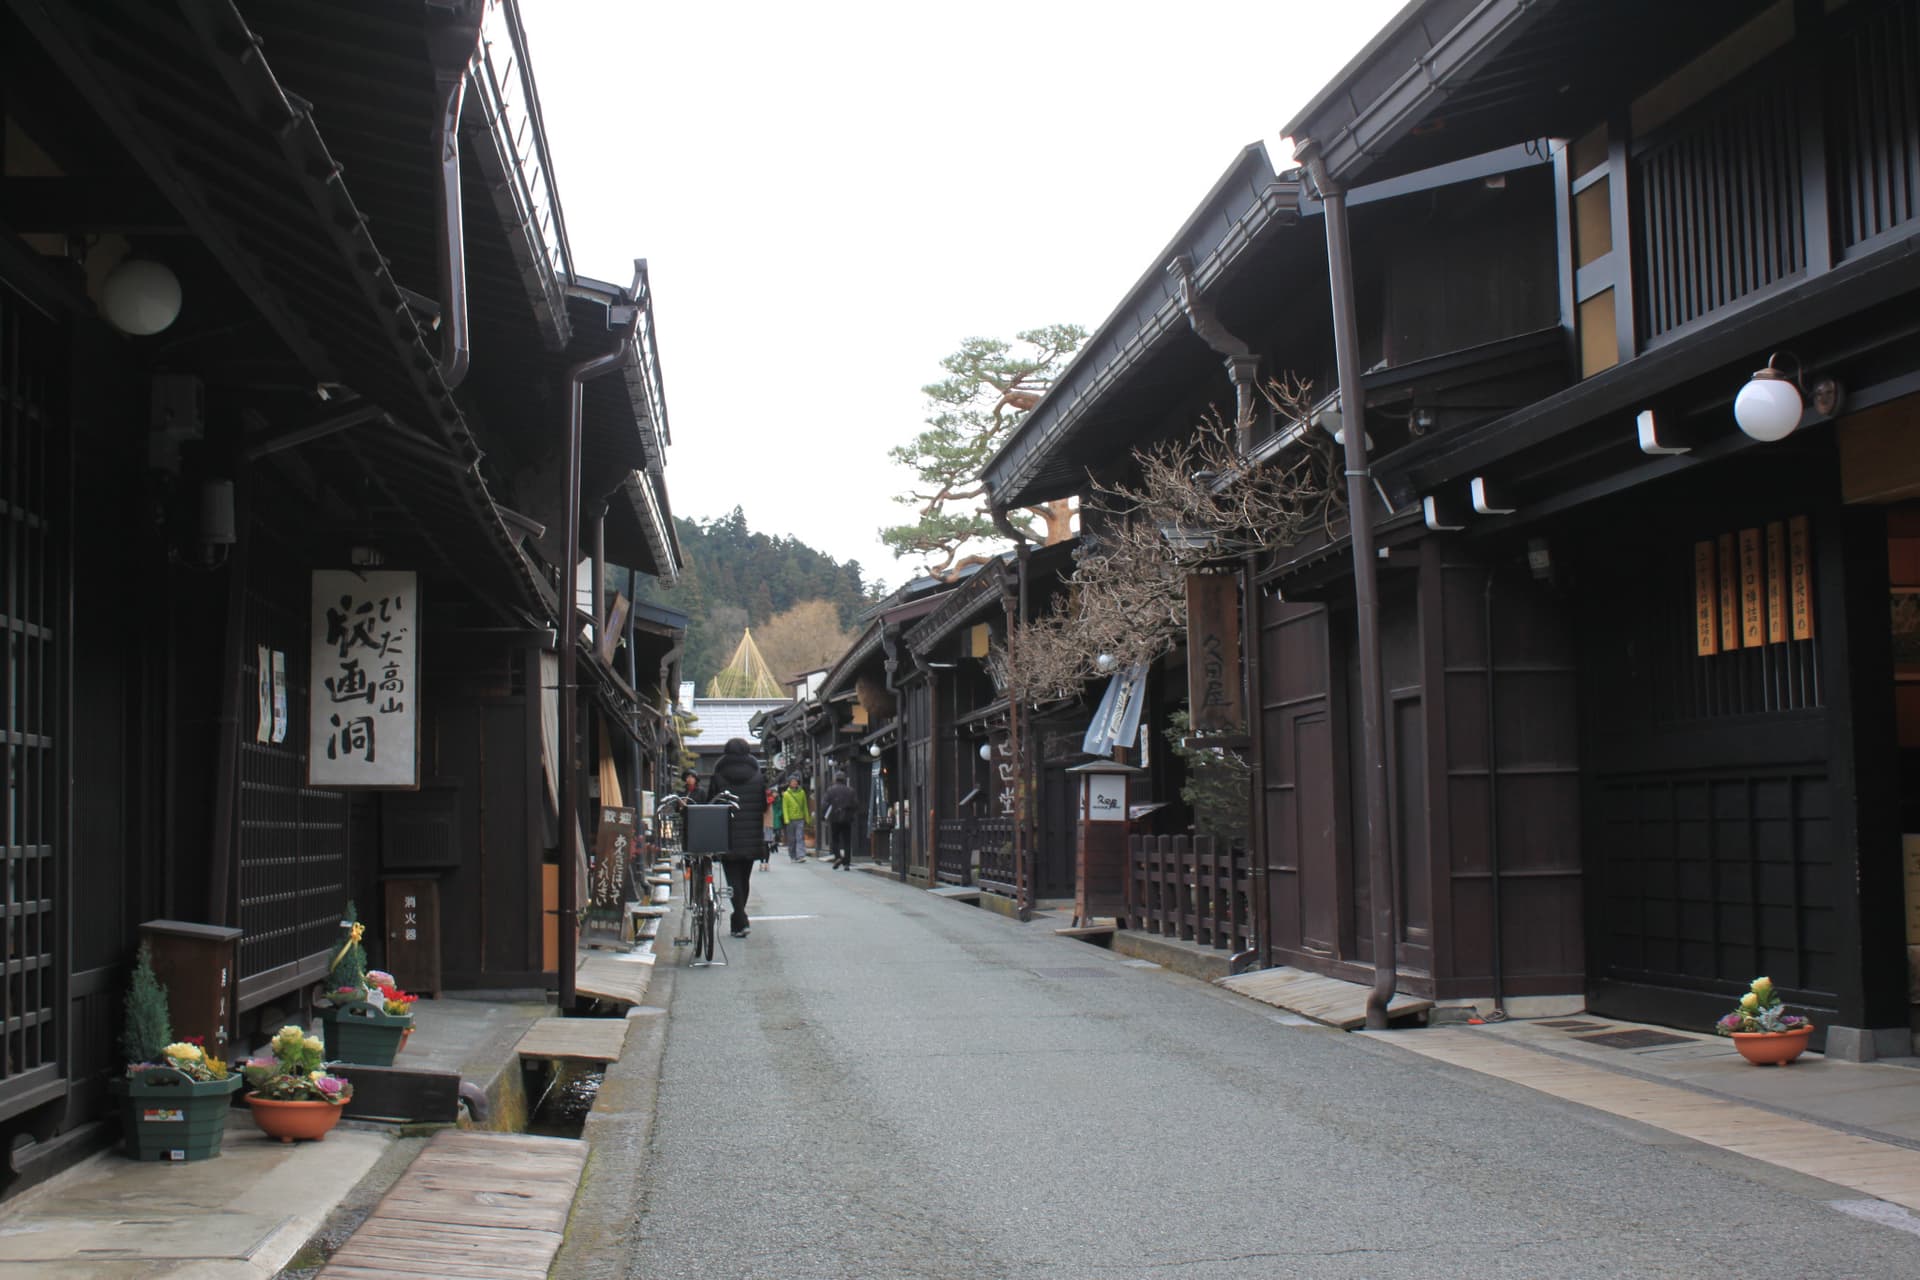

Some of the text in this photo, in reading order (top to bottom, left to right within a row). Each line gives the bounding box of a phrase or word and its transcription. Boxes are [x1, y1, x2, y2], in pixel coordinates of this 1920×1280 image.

[324, 594, 380, 763] 版画洞
[379, 596, 407, 714] ひだ高山
[603, 809, 632, 825] 歓迎
[404, 895, 417, 941] 消火器
